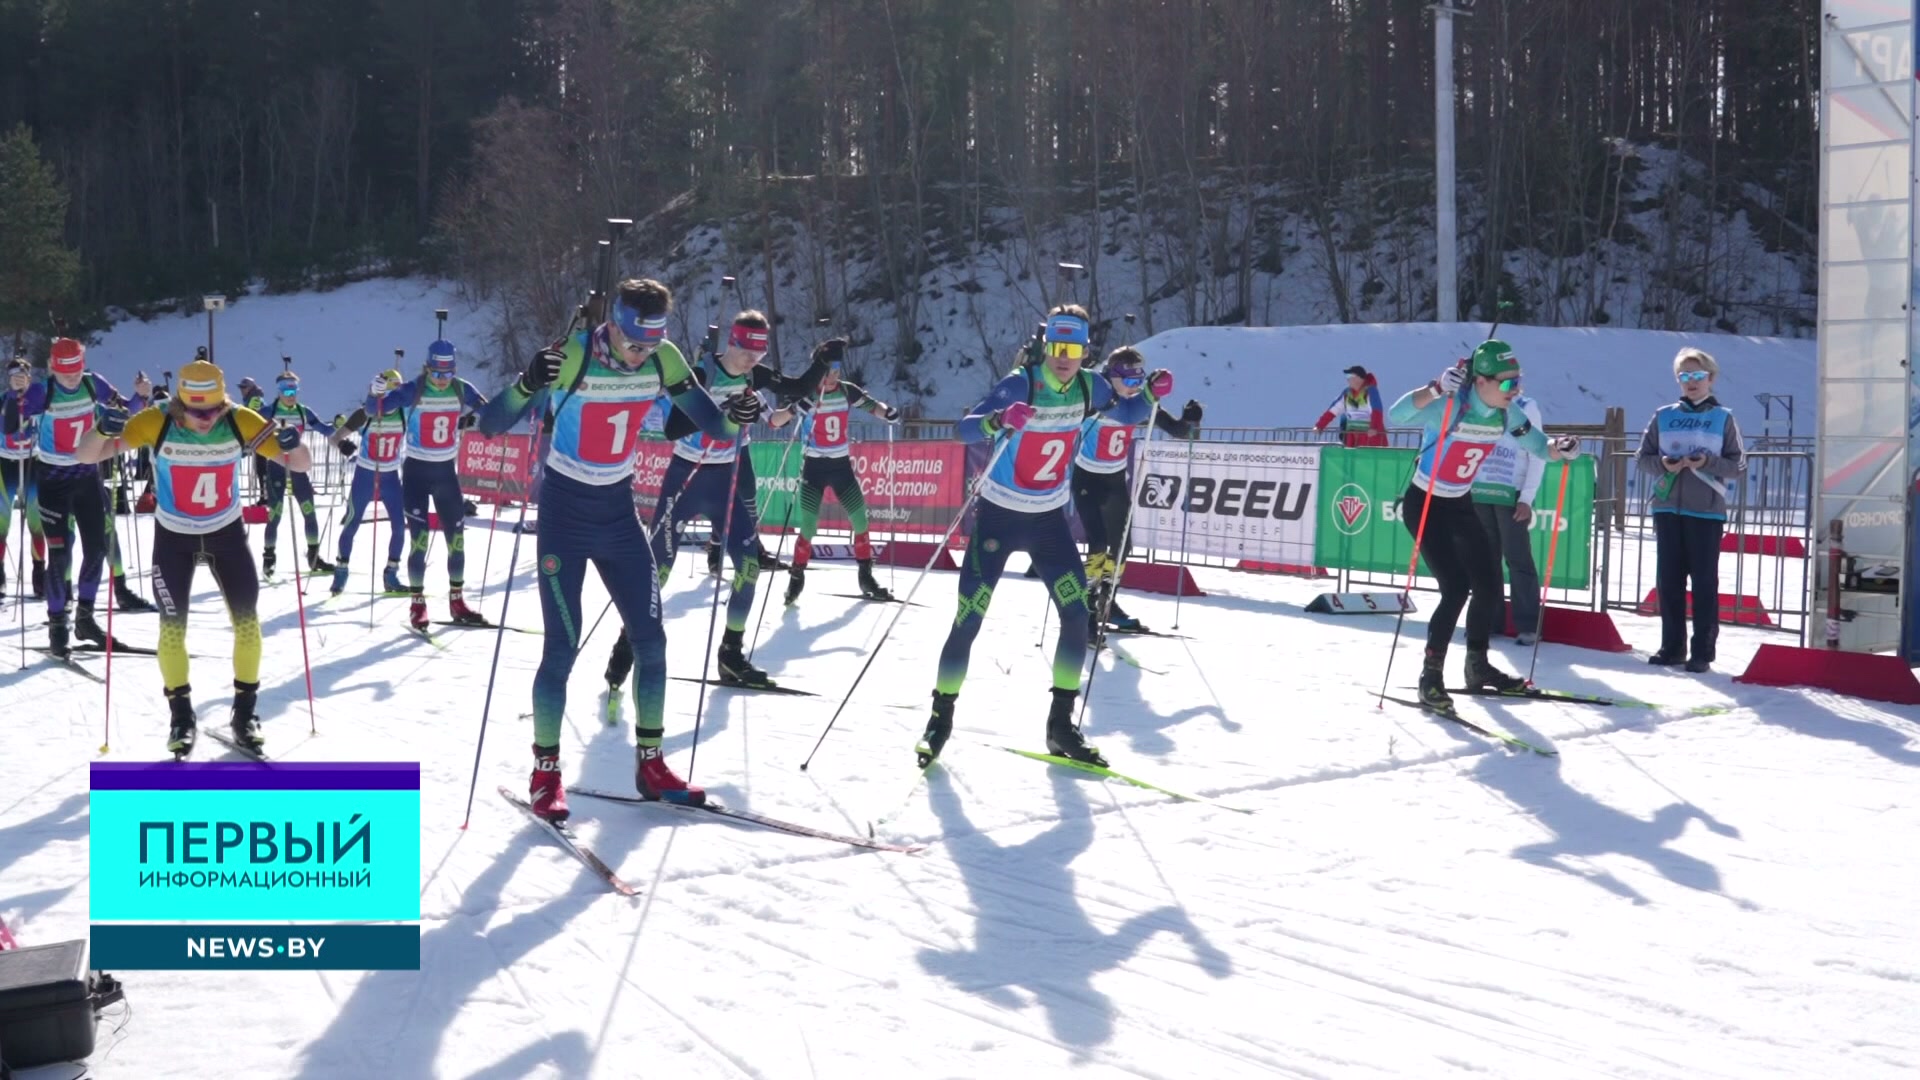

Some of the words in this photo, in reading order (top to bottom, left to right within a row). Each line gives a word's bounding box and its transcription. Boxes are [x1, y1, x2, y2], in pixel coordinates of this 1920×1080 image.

[69, 420, 85, 449] 7
[432, 416, 449, 443] 8
[607, 410, 630, 455] 1
[825, 416, 840, 441] 9
[378, 436, 396, 458] 11
[1108, 430, 1126, 456] 6
[871, 456, 943, 479] «Креатив
[1034, 440, 1065, 480] 2
[1146, 449, 1188, 459] ПОРТИВНАЯ
[1239, 454, 1315, 465] ПРОФЕССИОНАЛОВ
[1457, 448, 1484, 478] 3
[191, 472, 219, 509] 4
[855, 477, 938, 496] С-Восток»
[1181, 477, 1312, 521] BEEU
[816, 545, 833, 557] 10
[154, 577, 177, 616] BEEU
[1331, 593, 1345, 610] 4
[1361, 593, 1377, 610] 5
